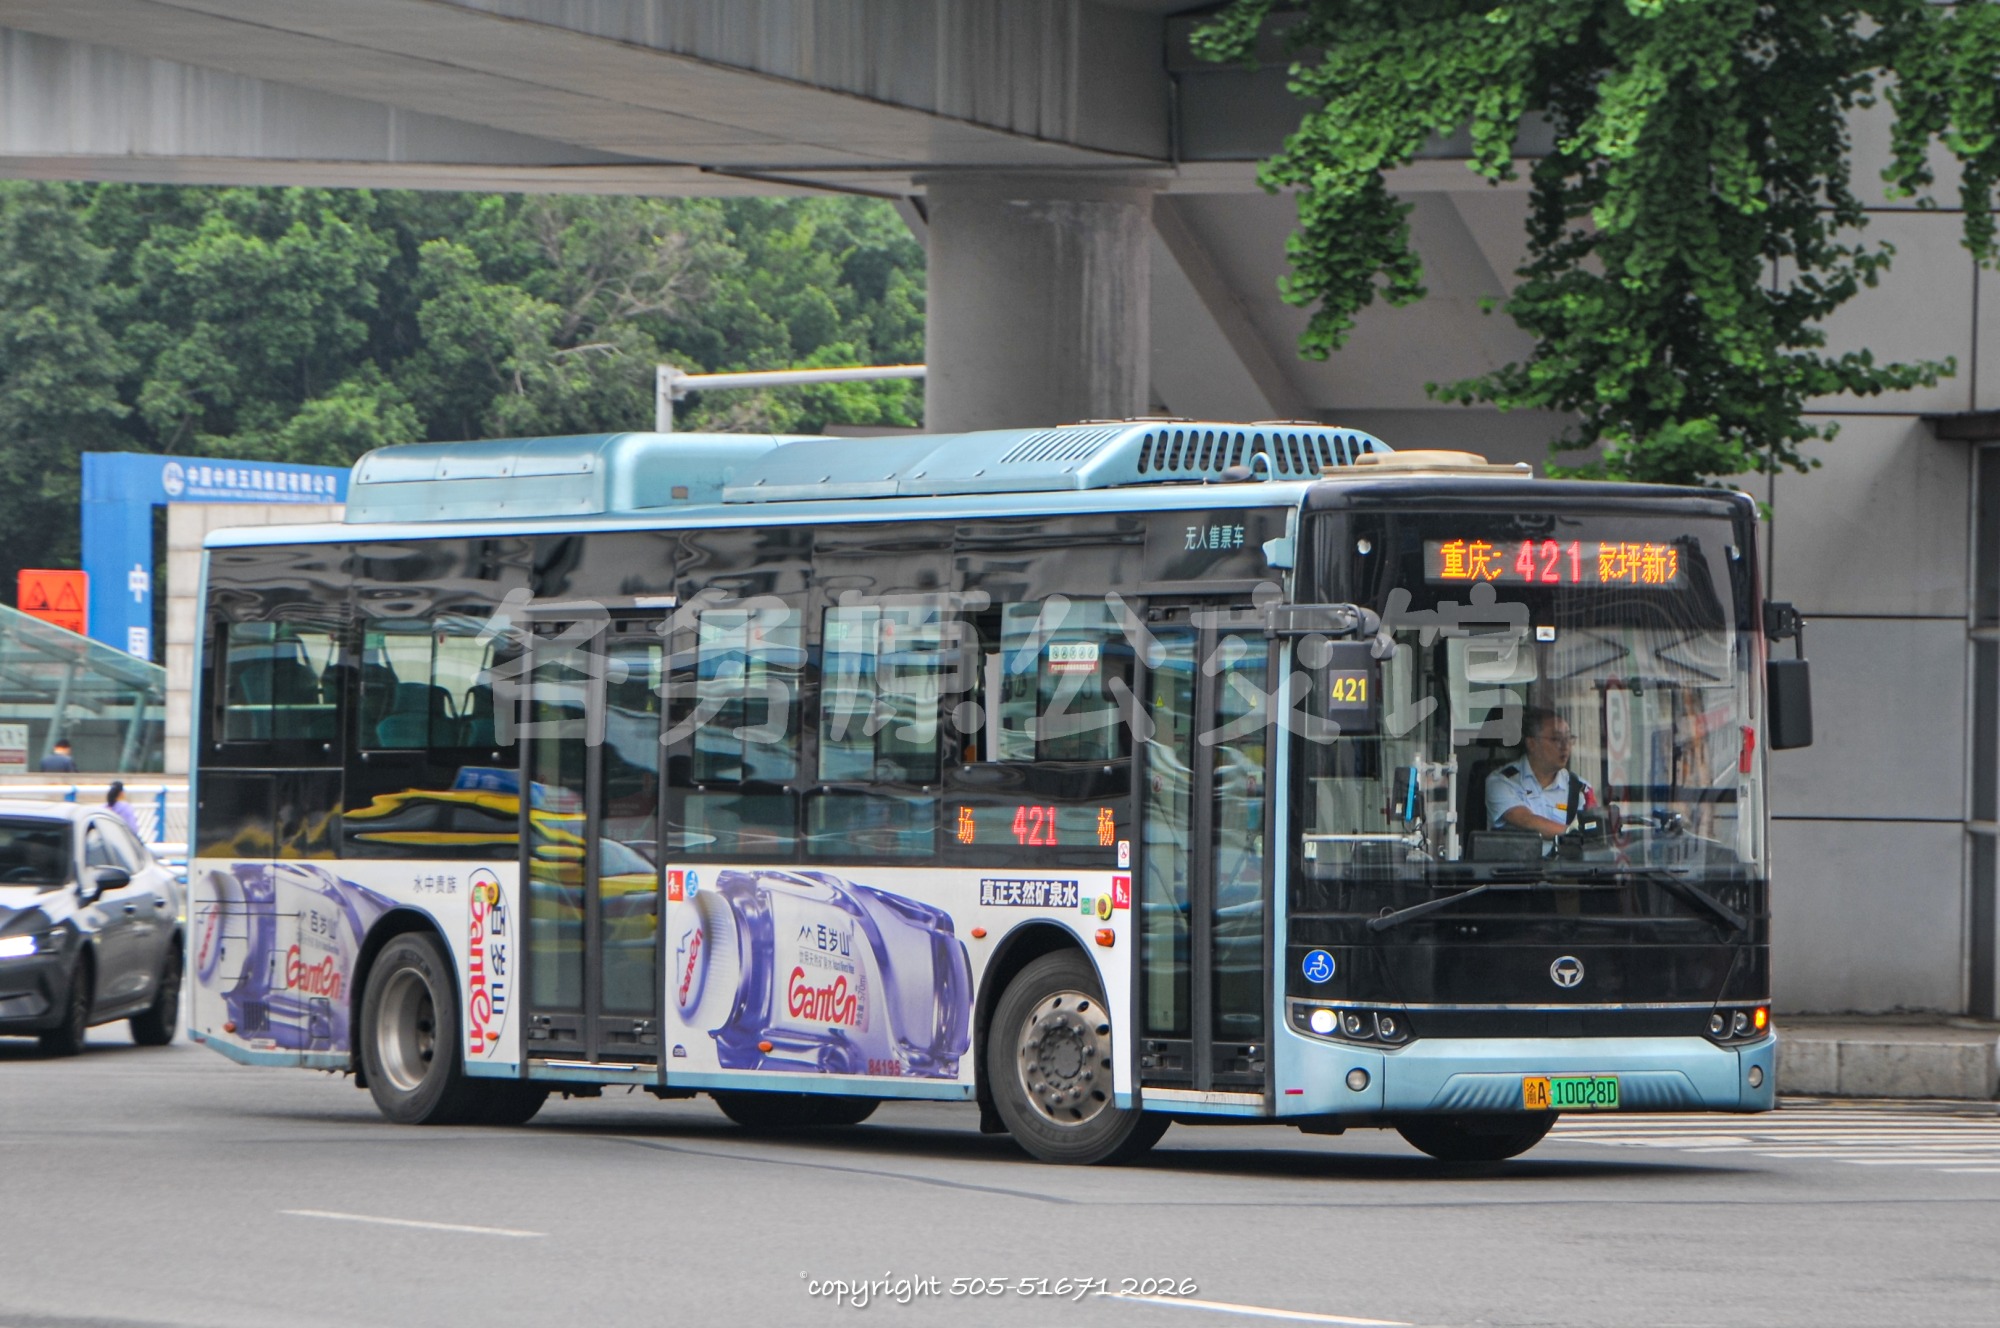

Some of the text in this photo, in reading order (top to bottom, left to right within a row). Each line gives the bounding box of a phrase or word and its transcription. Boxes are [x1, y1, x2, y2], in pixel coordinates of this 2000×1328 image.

[1184, 524, 1244, 550] 无人售票车
[1516, 540, 1580, 582] 421
[1332, 678, 1366, 701] 421
[1013, 806, 1057, 845] 421
[1097, 807, 1115, 845] 杨
[413, 874, 457, 894] 水中贵族
[982, 880, 1076, 907] 真正天然矿泉水
[817, 923, 850, 957] 百岁山
[491, 904, 505, 1014] 百岁山
[788, 966, 857, 1026] Ganten
[1557, 1081, 1617, 1105] 10028D
